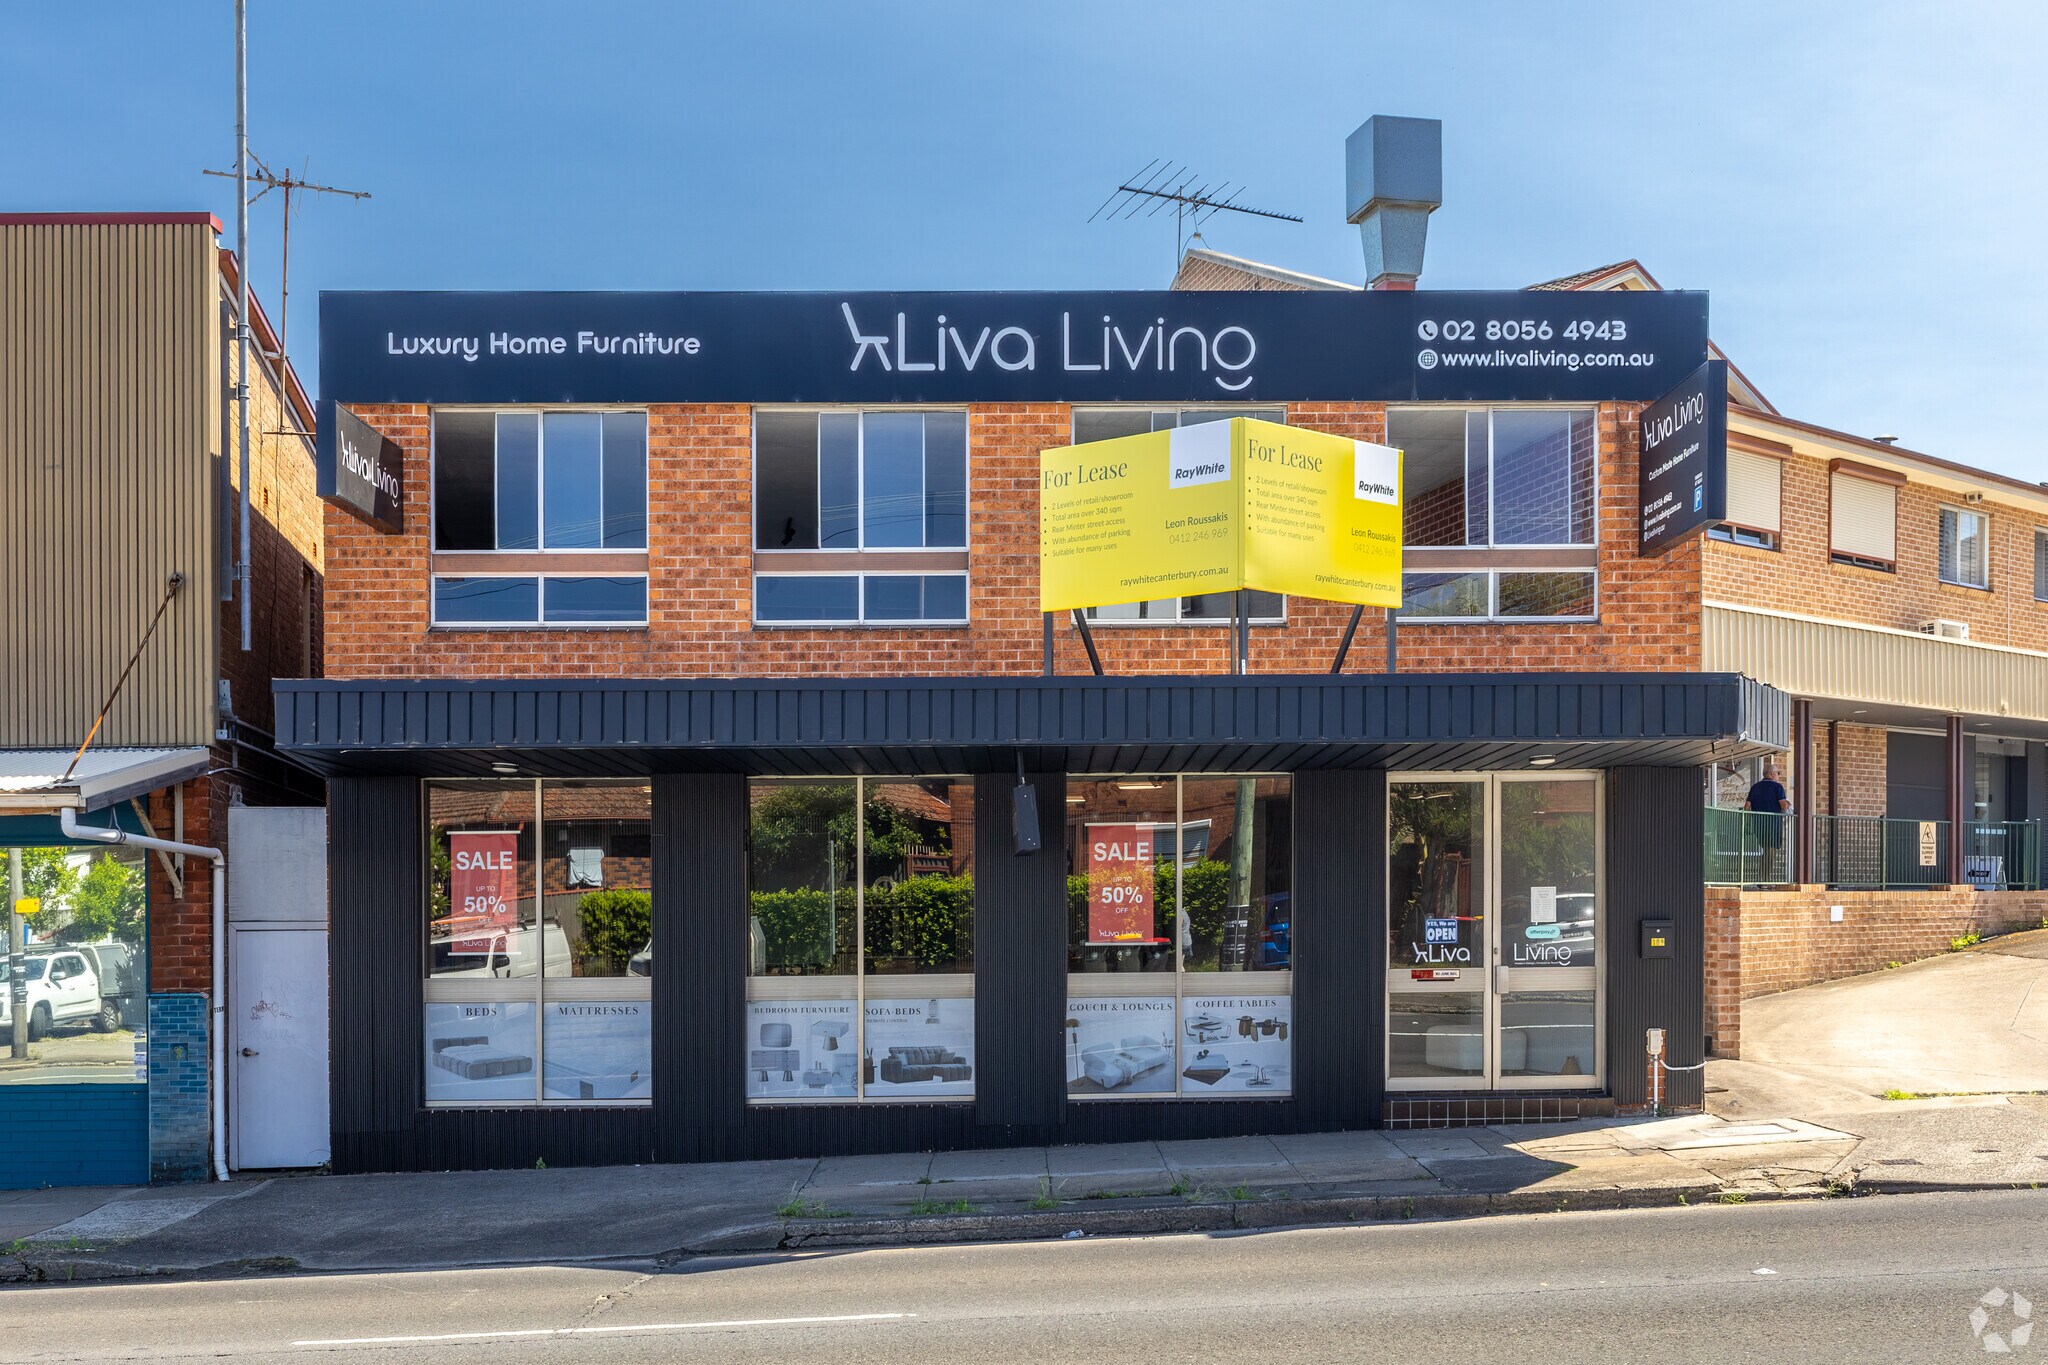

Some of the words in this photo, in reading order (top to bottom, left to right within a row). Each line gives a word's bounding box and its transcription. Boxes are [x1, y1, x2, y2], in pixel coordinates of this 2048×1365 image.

[1442, 320, 1476, 341] 02
[1485, 320, 1554, 341] 8056
[1562, 320, 1627, 341] 4943
[388, 332, 479, 361] Luxury
[489, 332, 567, 355] Home
[578, 331, 700, 355] Furniture
[897, 312, 1035, 371] Liva
[1063, 311, 1256, 391] Living
[1442, 350, 1654, 371] www.livaliving.com.au
[1652, 417, 1673, 448] Liva
[1674, 392, 1704, 432] Living
[1248, 438, 1275, 462] For
[1281, 445, 1323, 473] Lease
[349, 441, 369, 481] Liva
[371, 456, 398, 507] Living
[1044, 469, 1072, 489] For
[1078, 462, 1128, 484] Lease
[1175, 462, 1226, 480] RayWhite
[1256, 475, 1261, 484] 2
[1261, 476, 1278, 487] Levels
[1279, 480, 1285, 488] of
[1358, 480, 1394, 497] RayWhite
[1256, 488, 1270, 497] Total
[1283, 494, 1295, 502] over
[1052, 513, 1066, 522] Total
[1081, 510, 1094, 518] over
[1096, 506, 1108, 516] 340
[1109, 505, 1122, 514] sqm
[1057, 500, 1075, 510] Levels
[1075, 499, 1082, 507] of
[1256, 500, 1268, 509] Rear
[1304, 510, 1321, 519] access
[1051, 526, 1065, 534] Rear
[1066, 523, 1085, 531] Minter
[1087, 520, 1105, 529] street
[1106, 517, 1126, 526] access
[1165, 518, 1185, 530] Leon
[1187, 512, 1229, 526] Roussakis
[1256, 513, 1270, 522] With
[1271, 516, 1299, 527] abundance
[1306, 523, 1325, 533] parking
[1052, 537, 1067, 545] With
[1068, 534, 1099, 543] abundance
[1108, 528, 1131, 539] parking
[1169, 533, 1190, 545] 0412
[1193, 530, 1209, 542] 246
[1212, 528, 1228, 540] 969
[1256, 525, 1278, 535] Suitable
[1288, 532, 1301, 541] many
[1302, 534, 1314, 542] uses
[1351, 527, 1366, 538] Leon
[1367, 529, 1396, 543] Roussakis
[1052, 547, 1075, 557] Suitable
[1076, 546, 1084, 554] for
[1086, 544, 1102, 553] many
[1120, 567, 1229, 587] raywhitecanterbury.com.au
[1315, 574, 1396, 592] raywhitecanterbury.com.au
[1093, 841, 1150, 861] SALE
[456, 851, 513, 871] SALE
[475, 885, 485, 893] UP
[485, 885, 496, 893] TO
[1101, 886, 1143, 904] 50%
[464, 895, 507, 913] 50%
[1427, 927, 1456, 941] OPEN
[1428, 944, 1470, 962] Liva
[1513, 942, 1572, 966] Living
[465, 1007, 497, 1017] BEDS
[559, 1006, 639, 1016] MATTRESSES
[800, 1006, 850, 1014] FURNITURE
[865, 1007, 921, 1016] SOFA-BEDS
[1069, 1003, 1107, 1011] COUCH
[1111, 1003, 1119, 1011] &
[1122, 1002, 1172, 1011] LOUNGES
[1195, 1000, 1235, 1009] COFFEE
[1237, 999, 1277, 1008] TABLES
